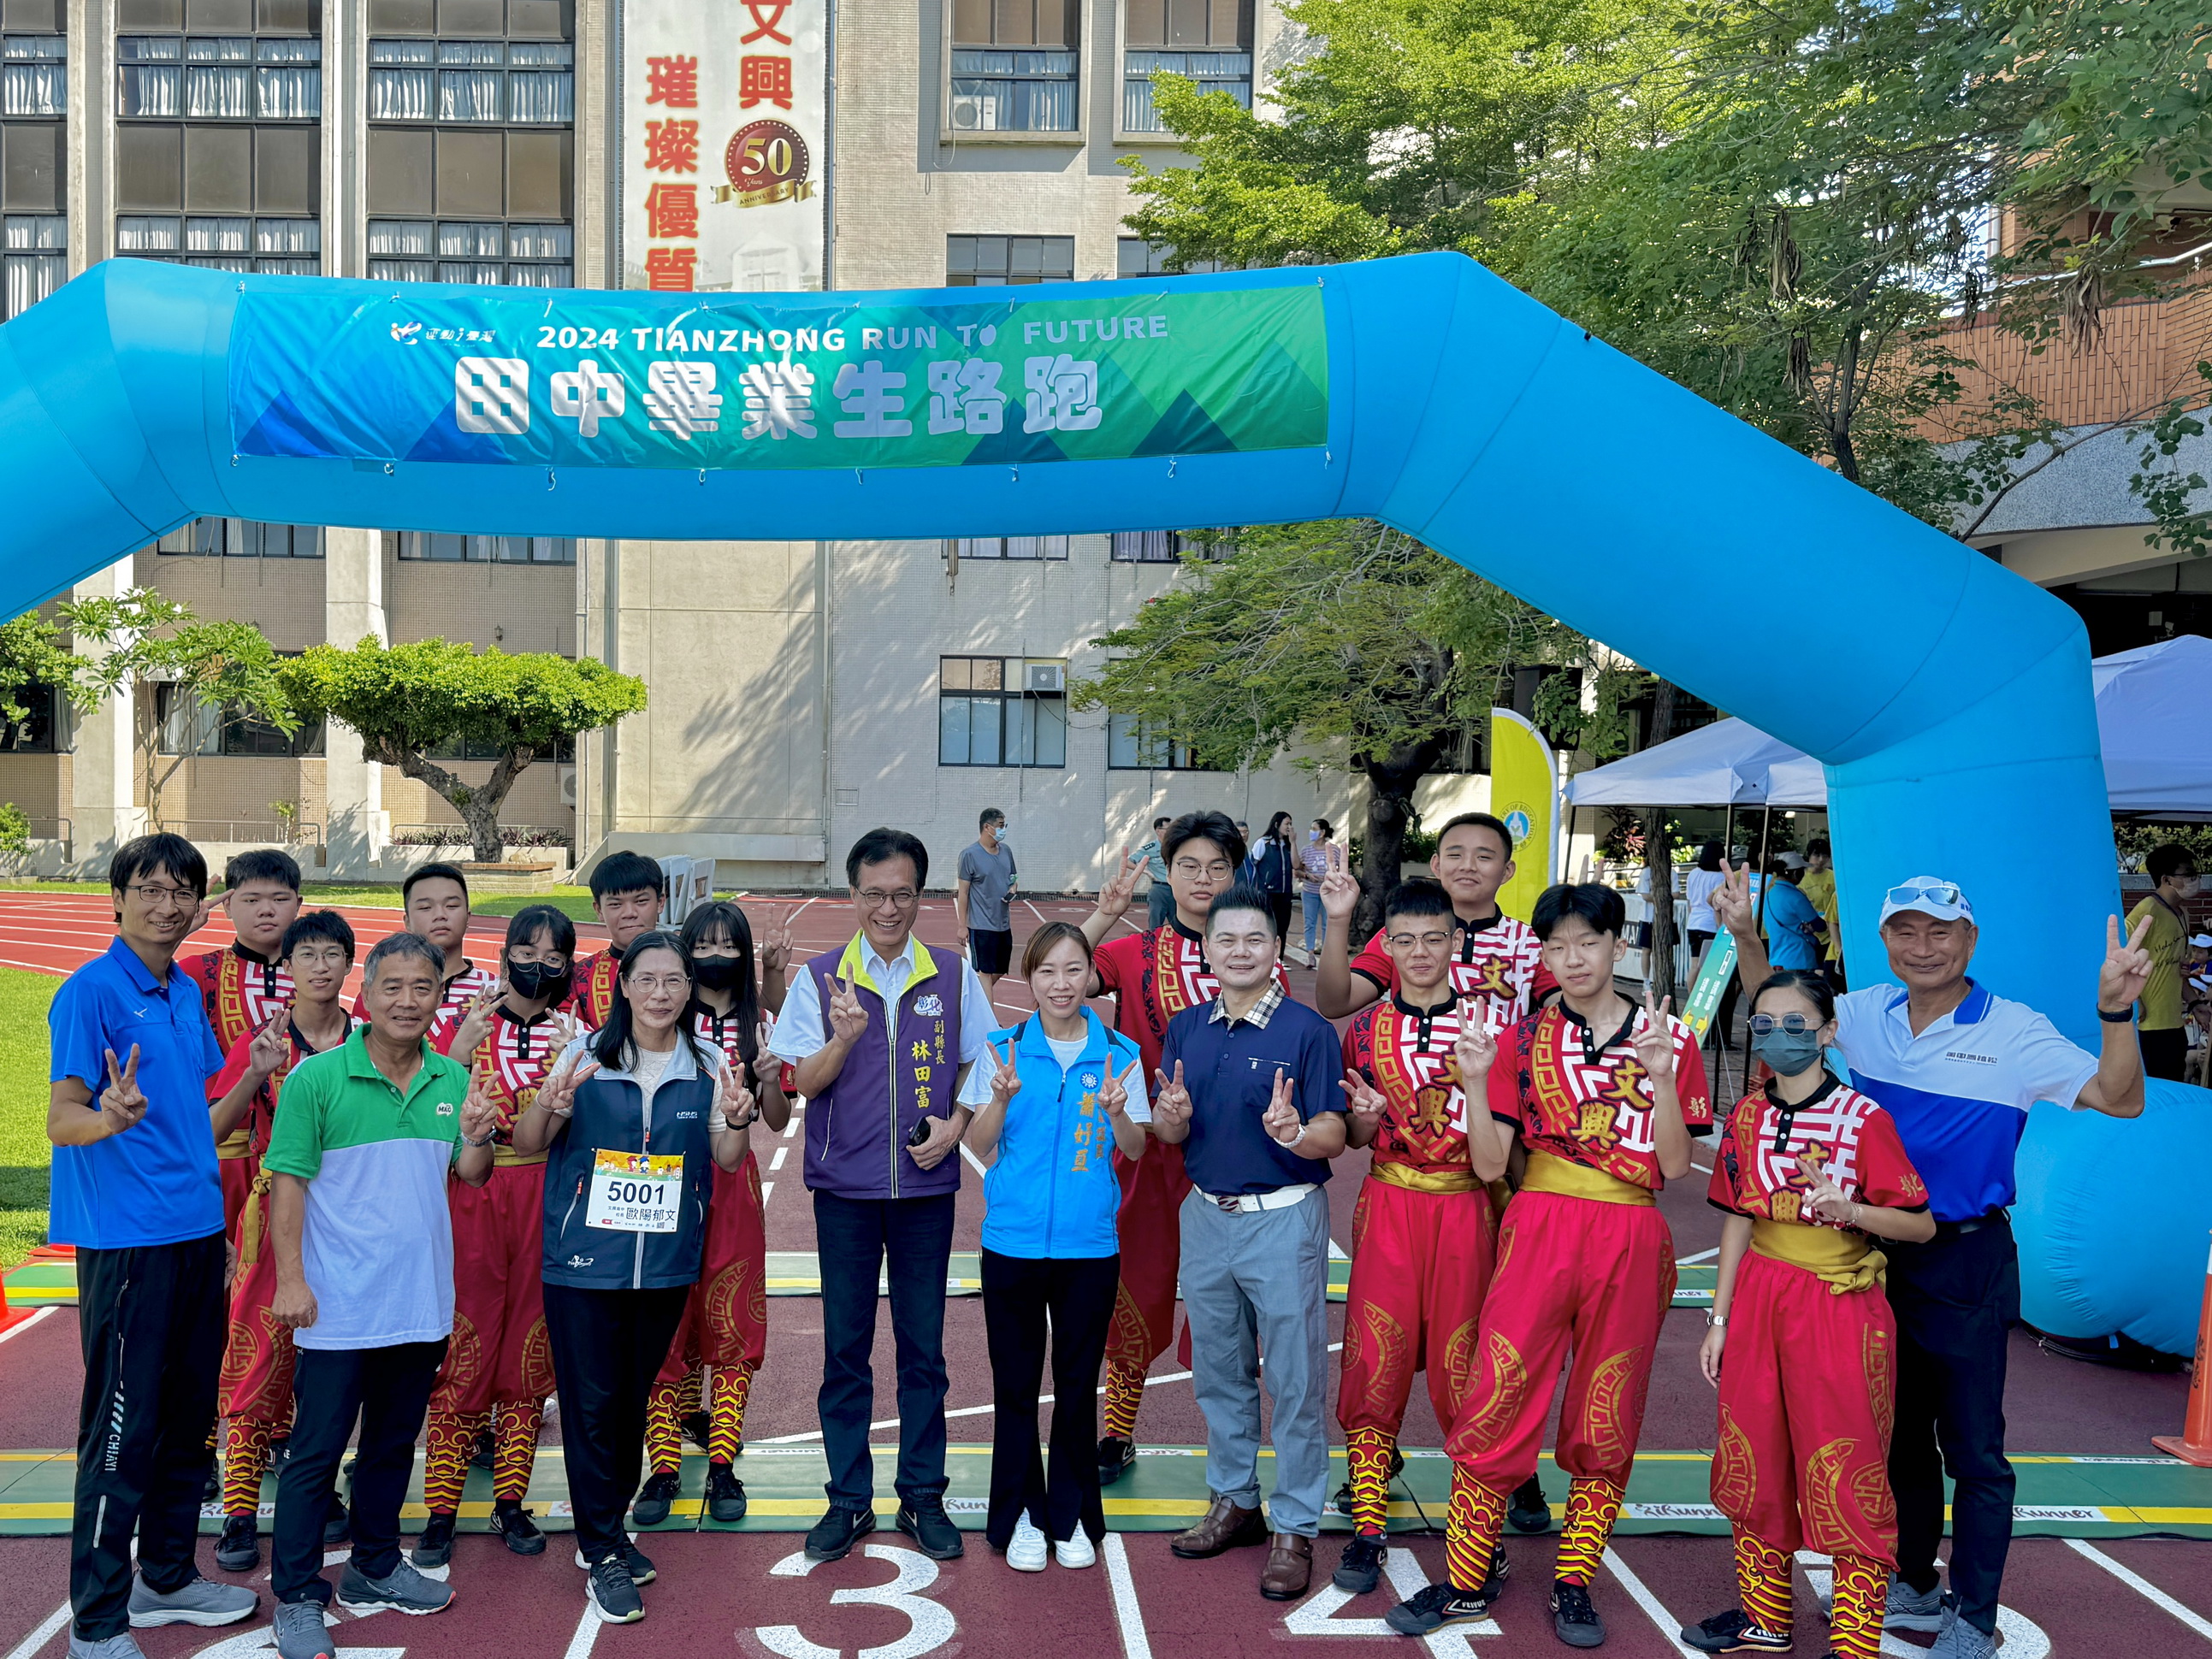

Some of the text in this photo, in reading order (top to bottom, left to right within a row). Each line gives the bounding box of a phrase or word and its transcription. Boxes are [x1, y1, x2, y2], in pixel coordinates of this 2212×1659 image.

[740, 0, 793, 109] 文興
[644, 55, 699, 292] 璀璨優質
[741, 138, 792, 176] 50
[739, 187, 790, 204] ANNIVERSARY
[536, 326, 618, 350] 2024
[635, 326, 845, 352] TIANZHONG
[862, 326, 937, 351] RUN
[1023, 315, 1168, 345] FUTURE
[455, 353, 1103, 440] 田中畢業生路跑
[933, 1020, 946, 1065] 副縣長
[912, 1039, 932, 1109] 林田富
[607, 1181, 665, 1204] 5001
[626, 1207, 676, 1221] 歐陽郁文
[104, 1434, 121, 1471] CHIAYI
[750, 1544, 955, 1659] 3
